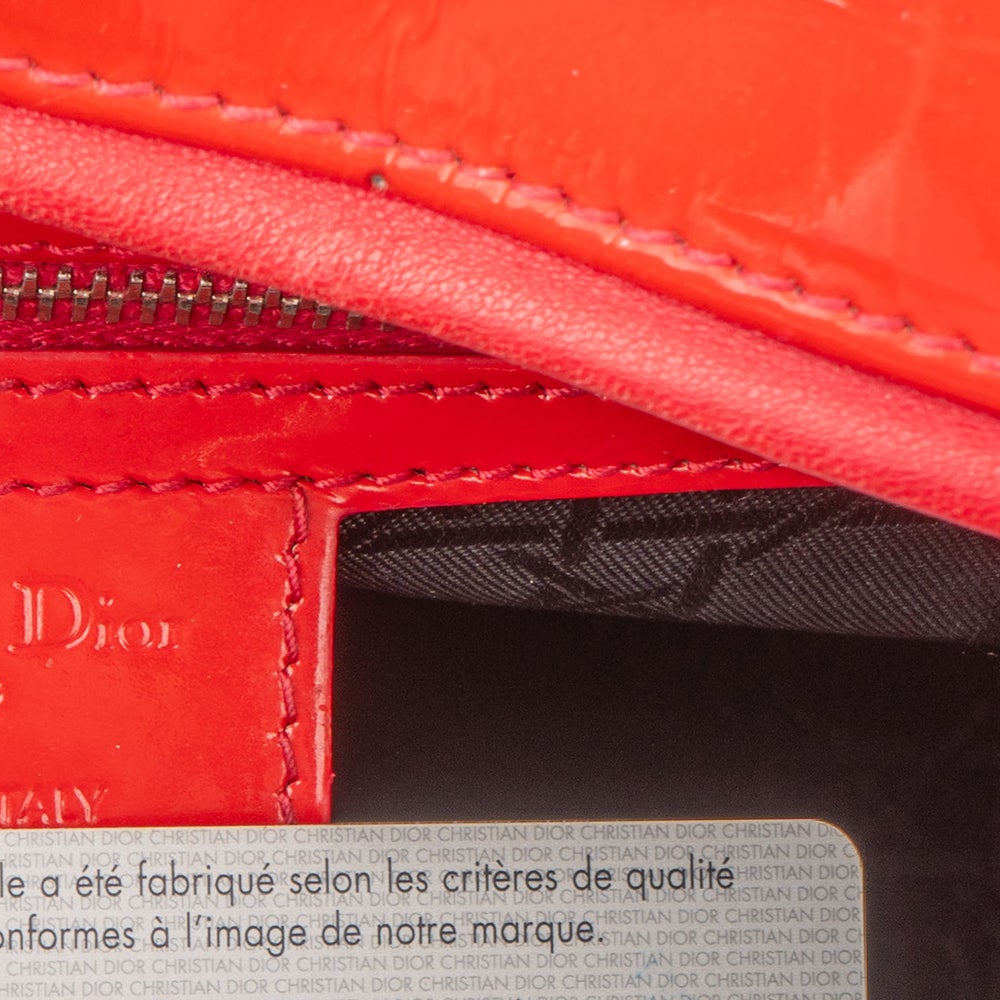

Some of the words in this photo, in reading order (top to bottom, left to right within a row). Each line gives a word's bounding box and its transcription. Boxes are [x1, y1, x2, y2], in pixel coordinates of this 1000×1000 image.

[8, 582, 180, 652] Dior
[41, 876, 59, 898] a
[76, 863, 122, 897] été
[138, 858, 274, 907] fabriqué
[290, 856, 371, 895] selon
[387, 855, 428, 893] les
[442, 859, 558, 893] critères
[572, 852, 613, 891] de
[626, 852, 735, 901] qualité
[150, 915, 169, 948] à
[186, 911, 306, 957] l'image
[321, 908, 361, 945] de
[377, 915, 457, 946] notre
[472, 919, 604, 954] marque.
